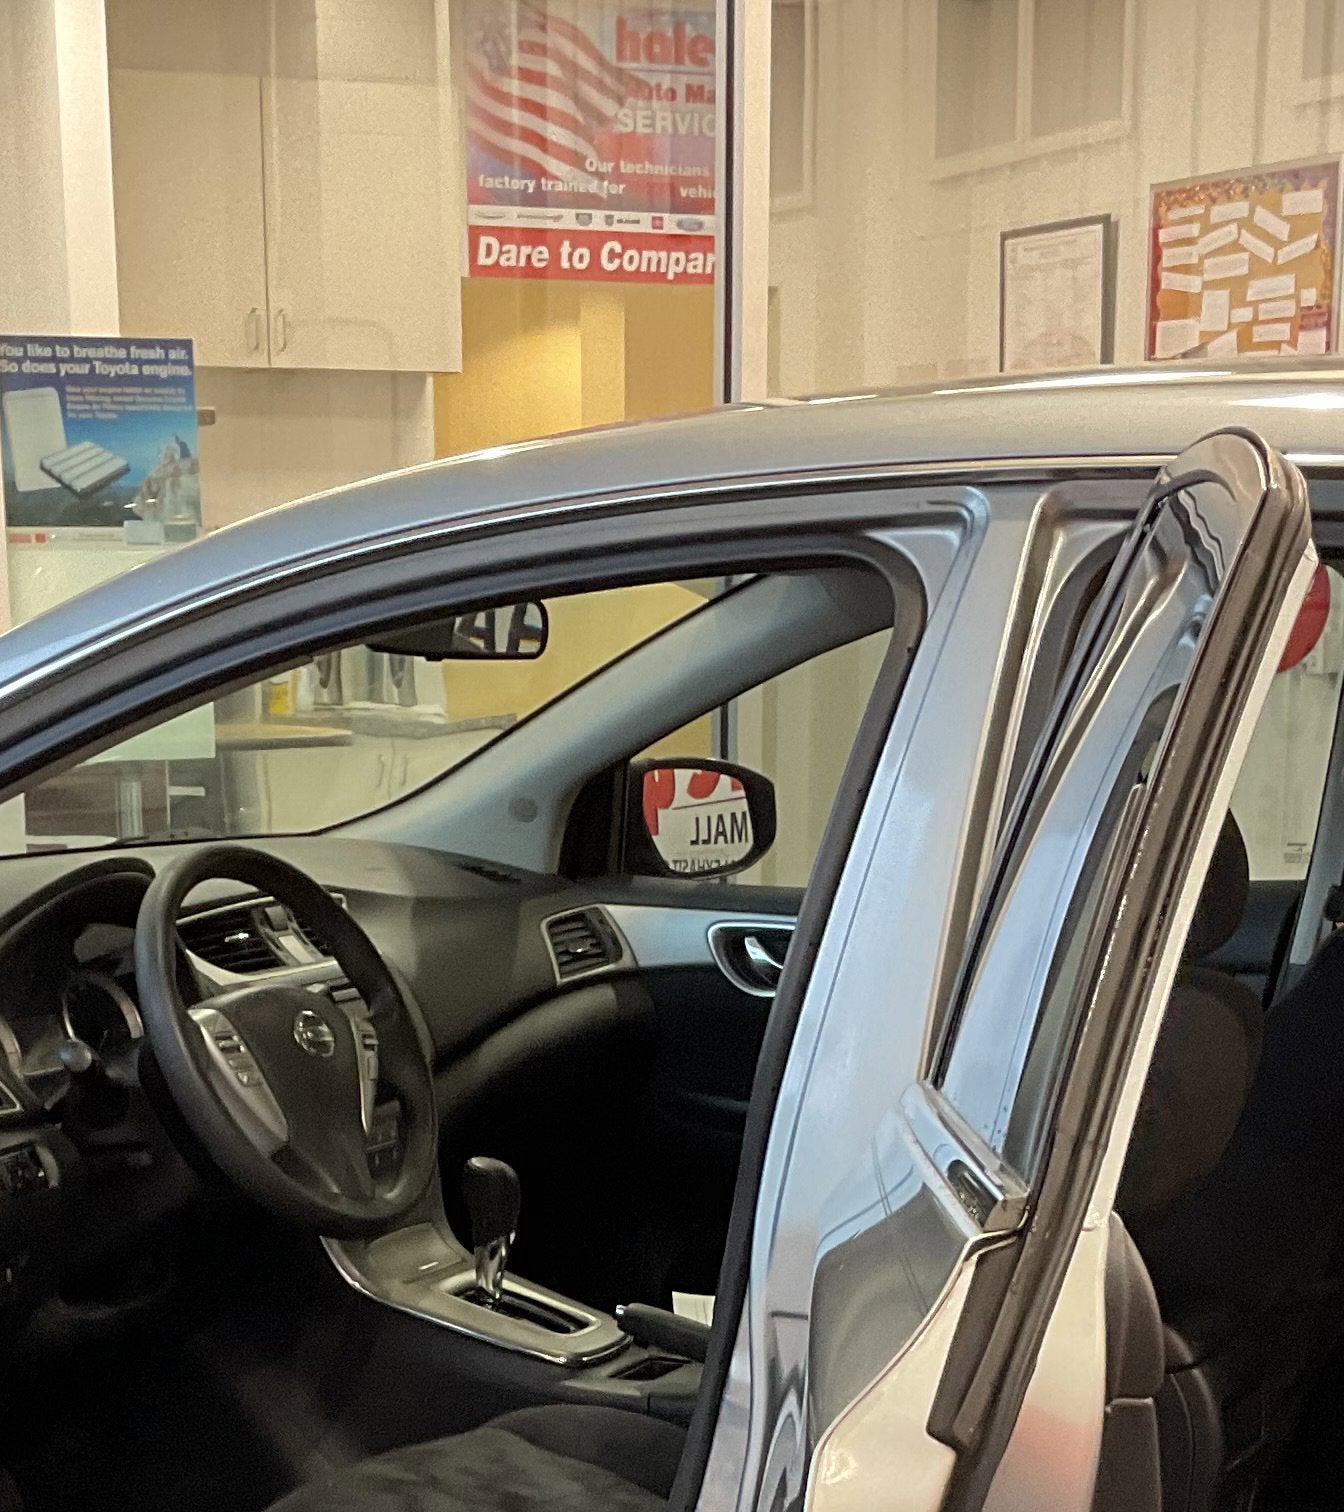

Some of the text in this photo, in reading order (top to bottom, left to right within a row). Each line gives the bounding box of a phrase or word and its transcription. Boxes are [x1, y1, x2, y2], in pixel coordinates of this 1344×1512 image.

[585, 158, 710, 177] Our technicians
[478, 174, 536, 193] factory
[541, 177, 599, 193] trained
[603, 180, 626, 194] for
[477, 236, 715, 280] Dare to Compar
[26, 343, 52, 357] like
[55, 344, 70, 357] to
[73, 345, 127, 359] breathe
[130, 345, 165, 360] fresh
[168, 346, 189, 360] air.
[0, 359, 193, 378] So does your Toyota engine.
